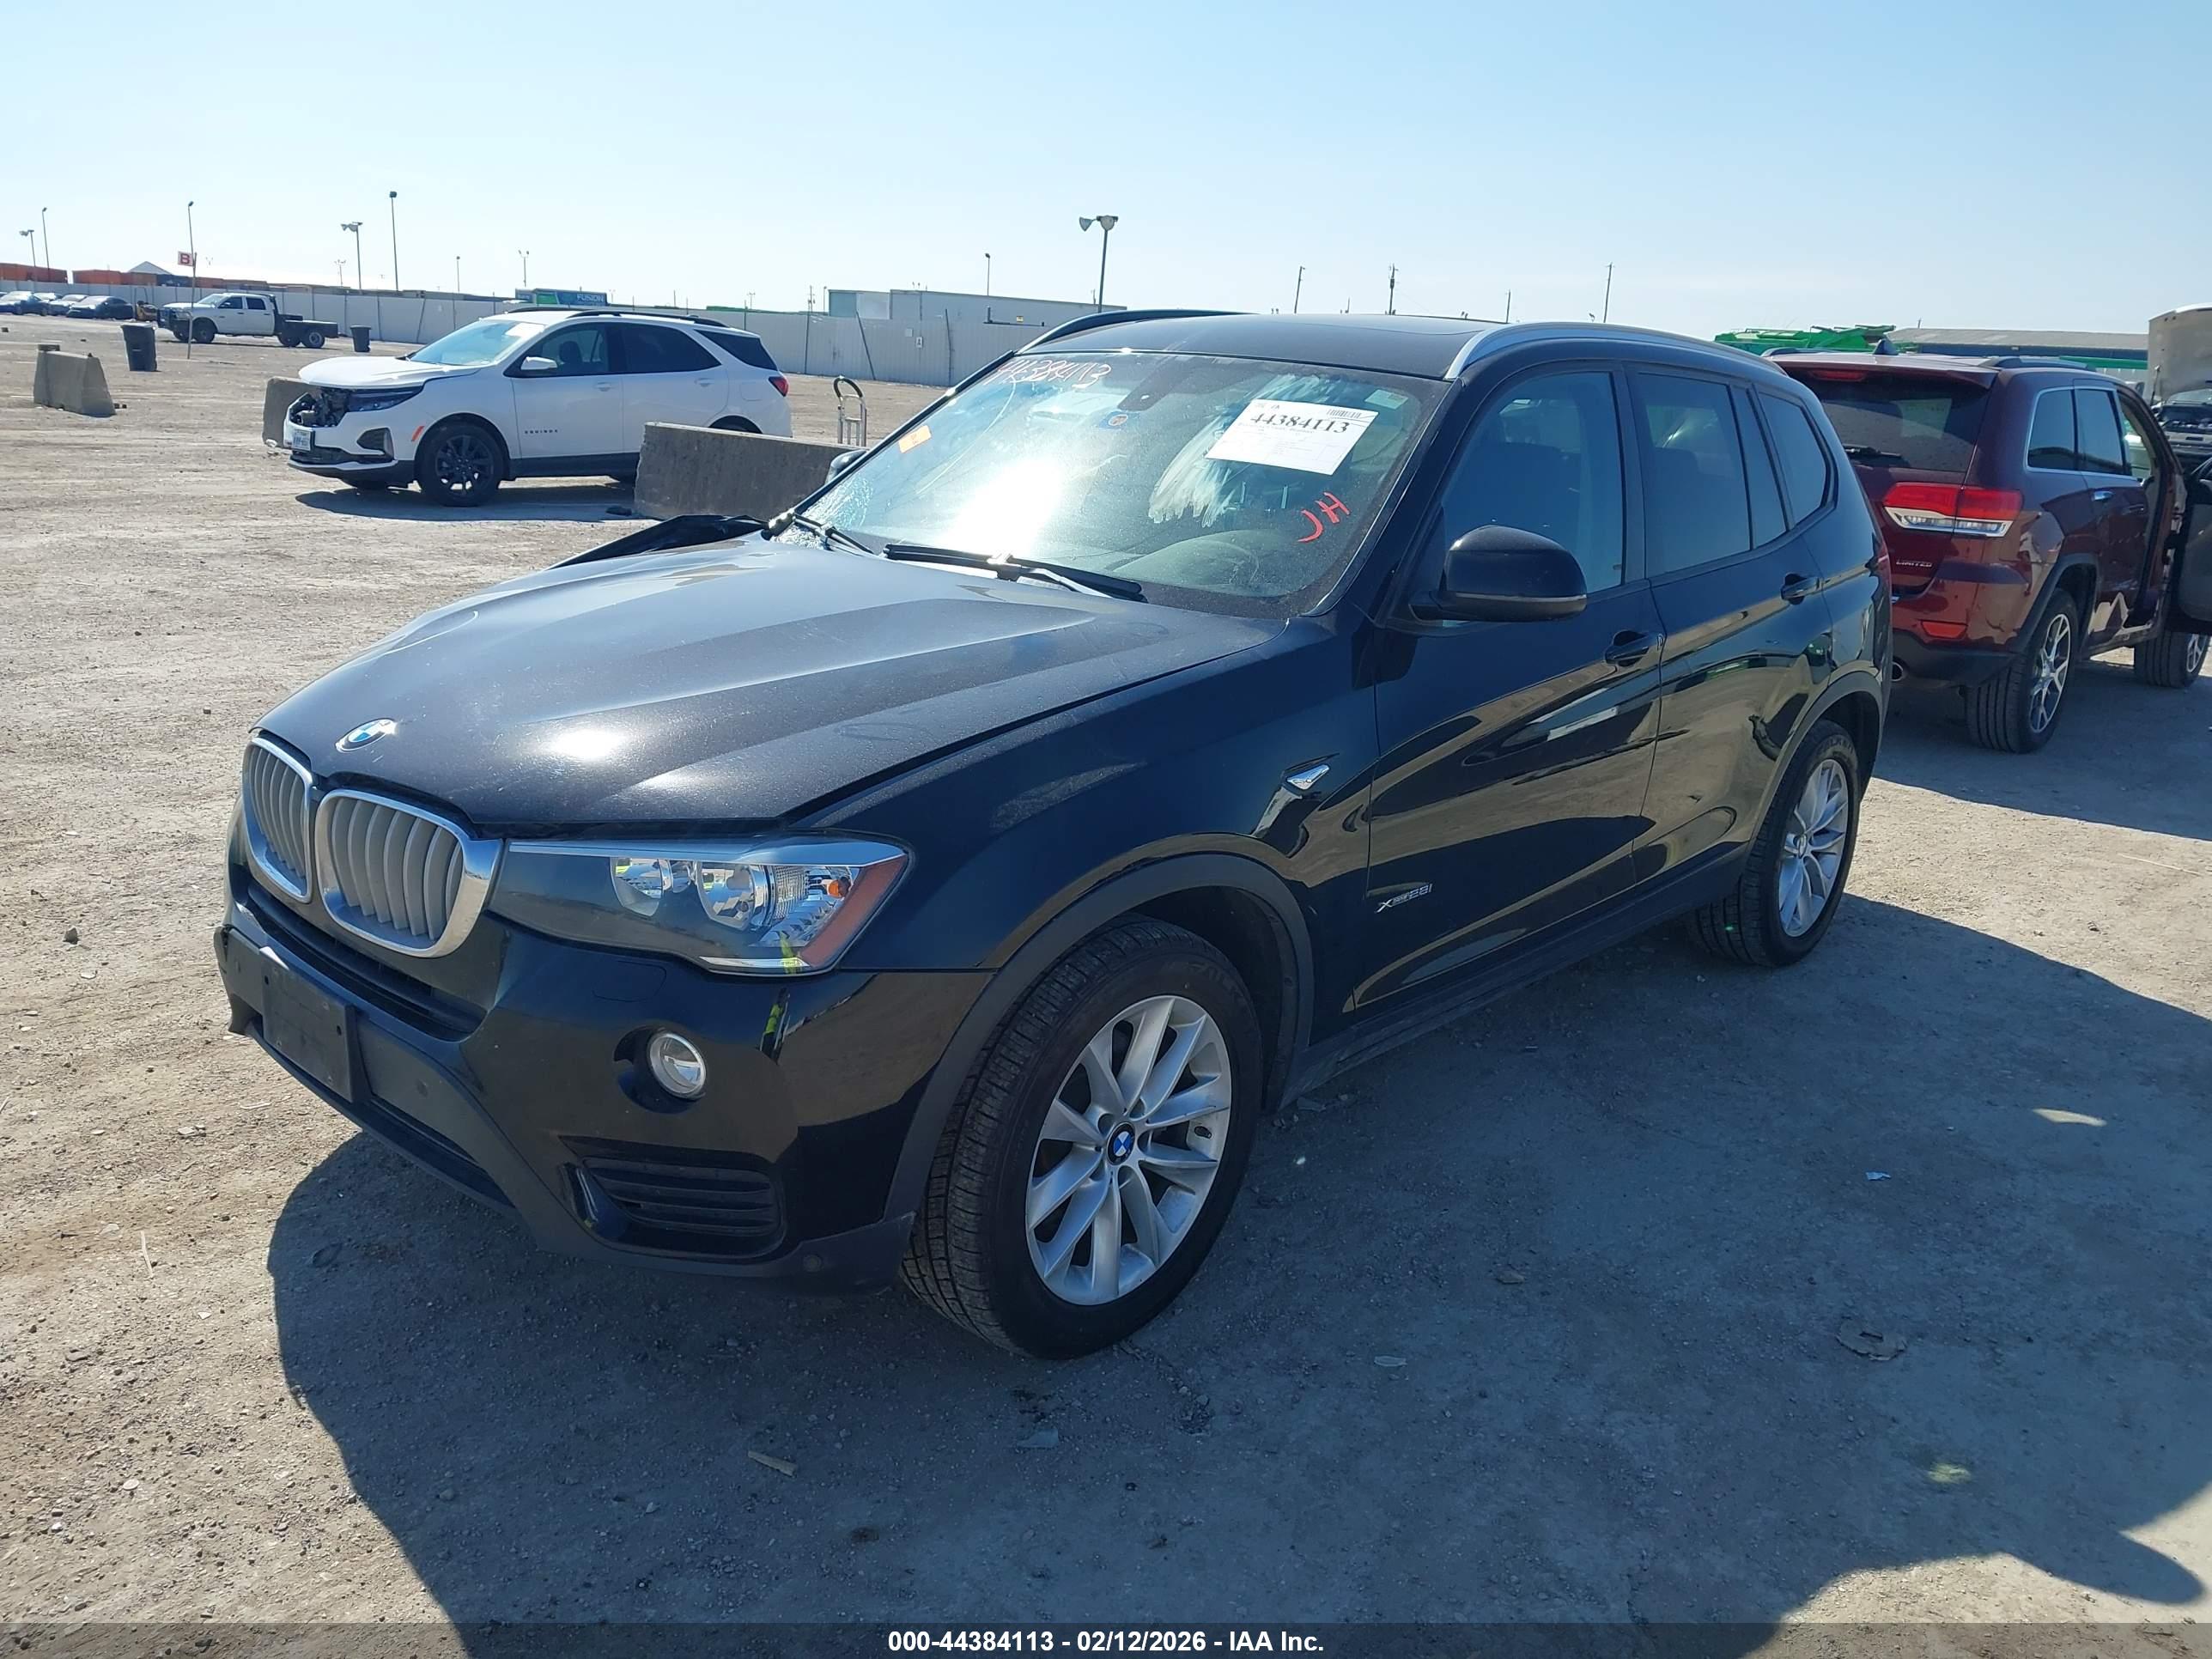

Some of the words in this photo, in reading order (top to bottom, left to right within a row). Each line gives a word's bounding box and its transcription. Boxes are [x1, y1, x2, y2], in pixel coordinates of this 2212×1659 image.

[180, 252, 191, 264] B
[576, 293, 605, 303] FUSION
[1249, 412, 1351, 434] 44384113
